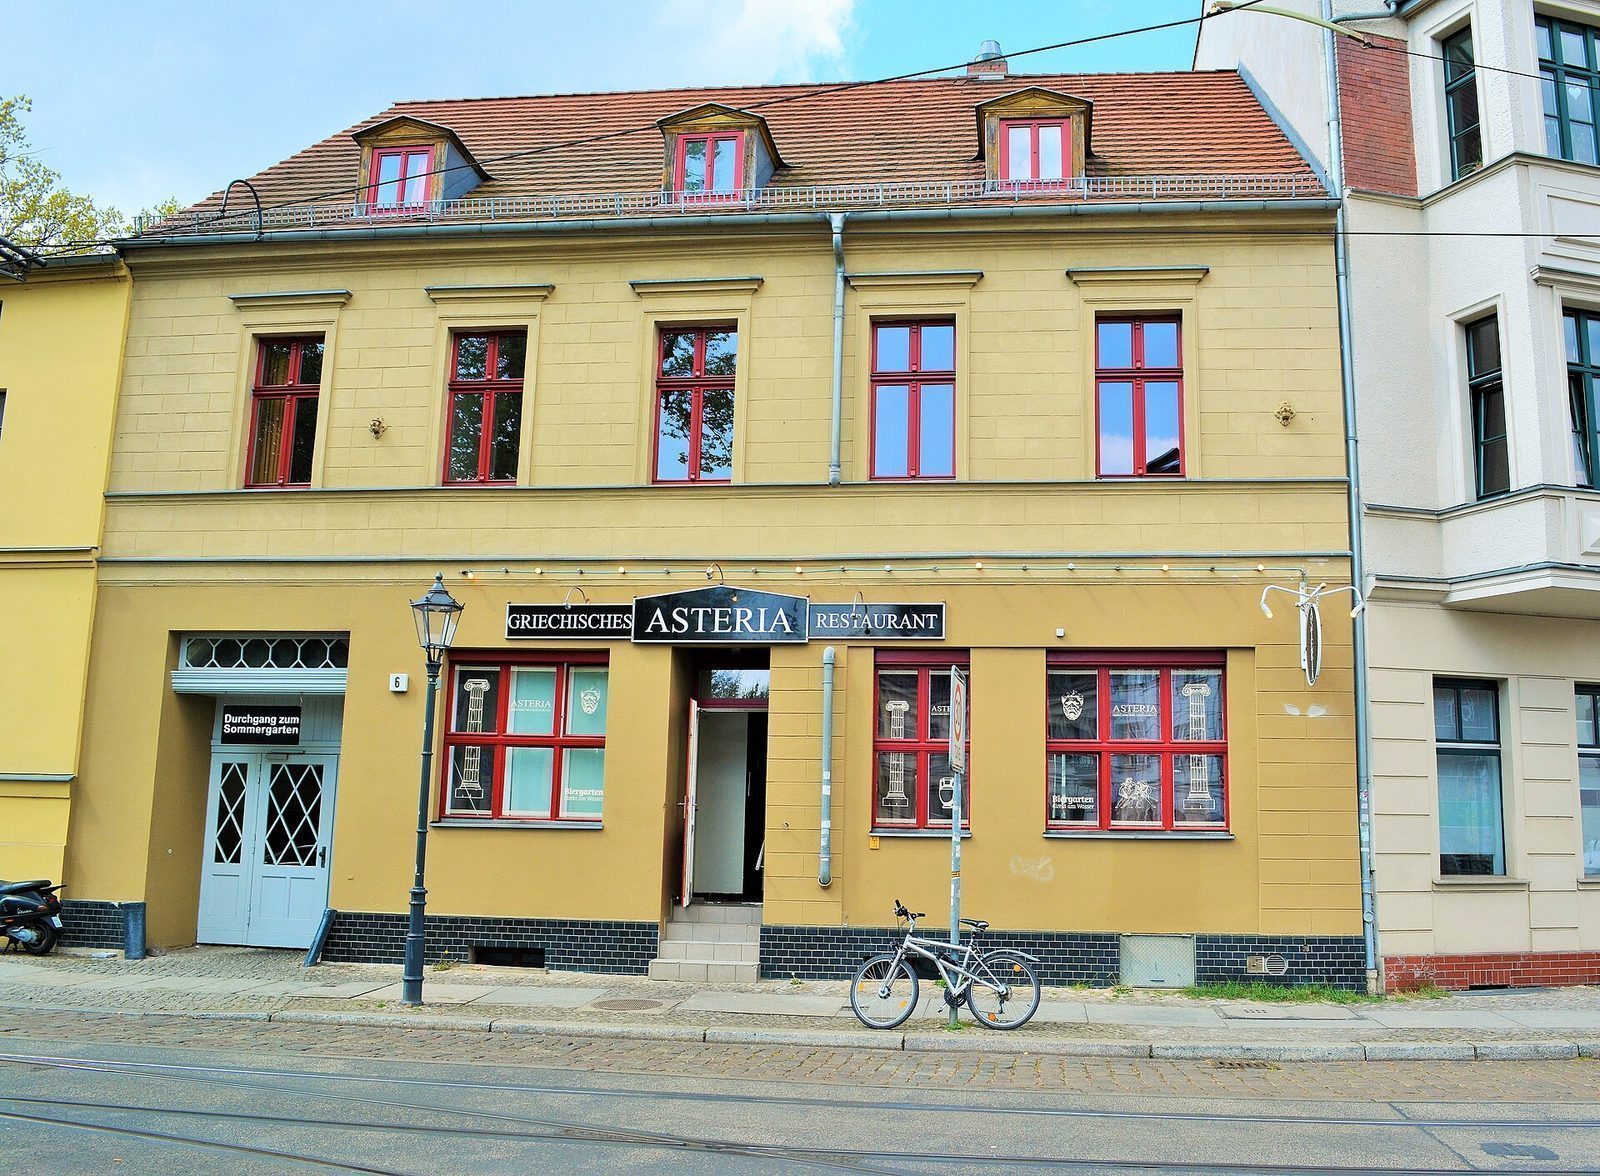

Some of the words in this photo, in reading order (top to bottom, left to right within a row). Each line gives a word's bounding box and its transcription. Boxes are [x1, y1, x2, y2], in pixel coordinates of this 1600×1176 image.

[507, 614, 632, 629] GRIECHISCHES
[644, 607, 793, 634] ASTERIA
[816, 613, 938, 629] RESTAURANT
[394, 676, 400, 688] 6
[511, 700, 551, 708] ASTERIA
[931, 705, 951, 713] ASTE
[1112, 704, 1158, 713] ASTERIA
[224, 713, 277, 726] Durchgang
[278, 716, 300, 724] zum
[223, 724, 299, 736] Sommergarten
[564, 788, 604, 797] Biergarten
[1052, 795, 1094, 805] Biergarten
